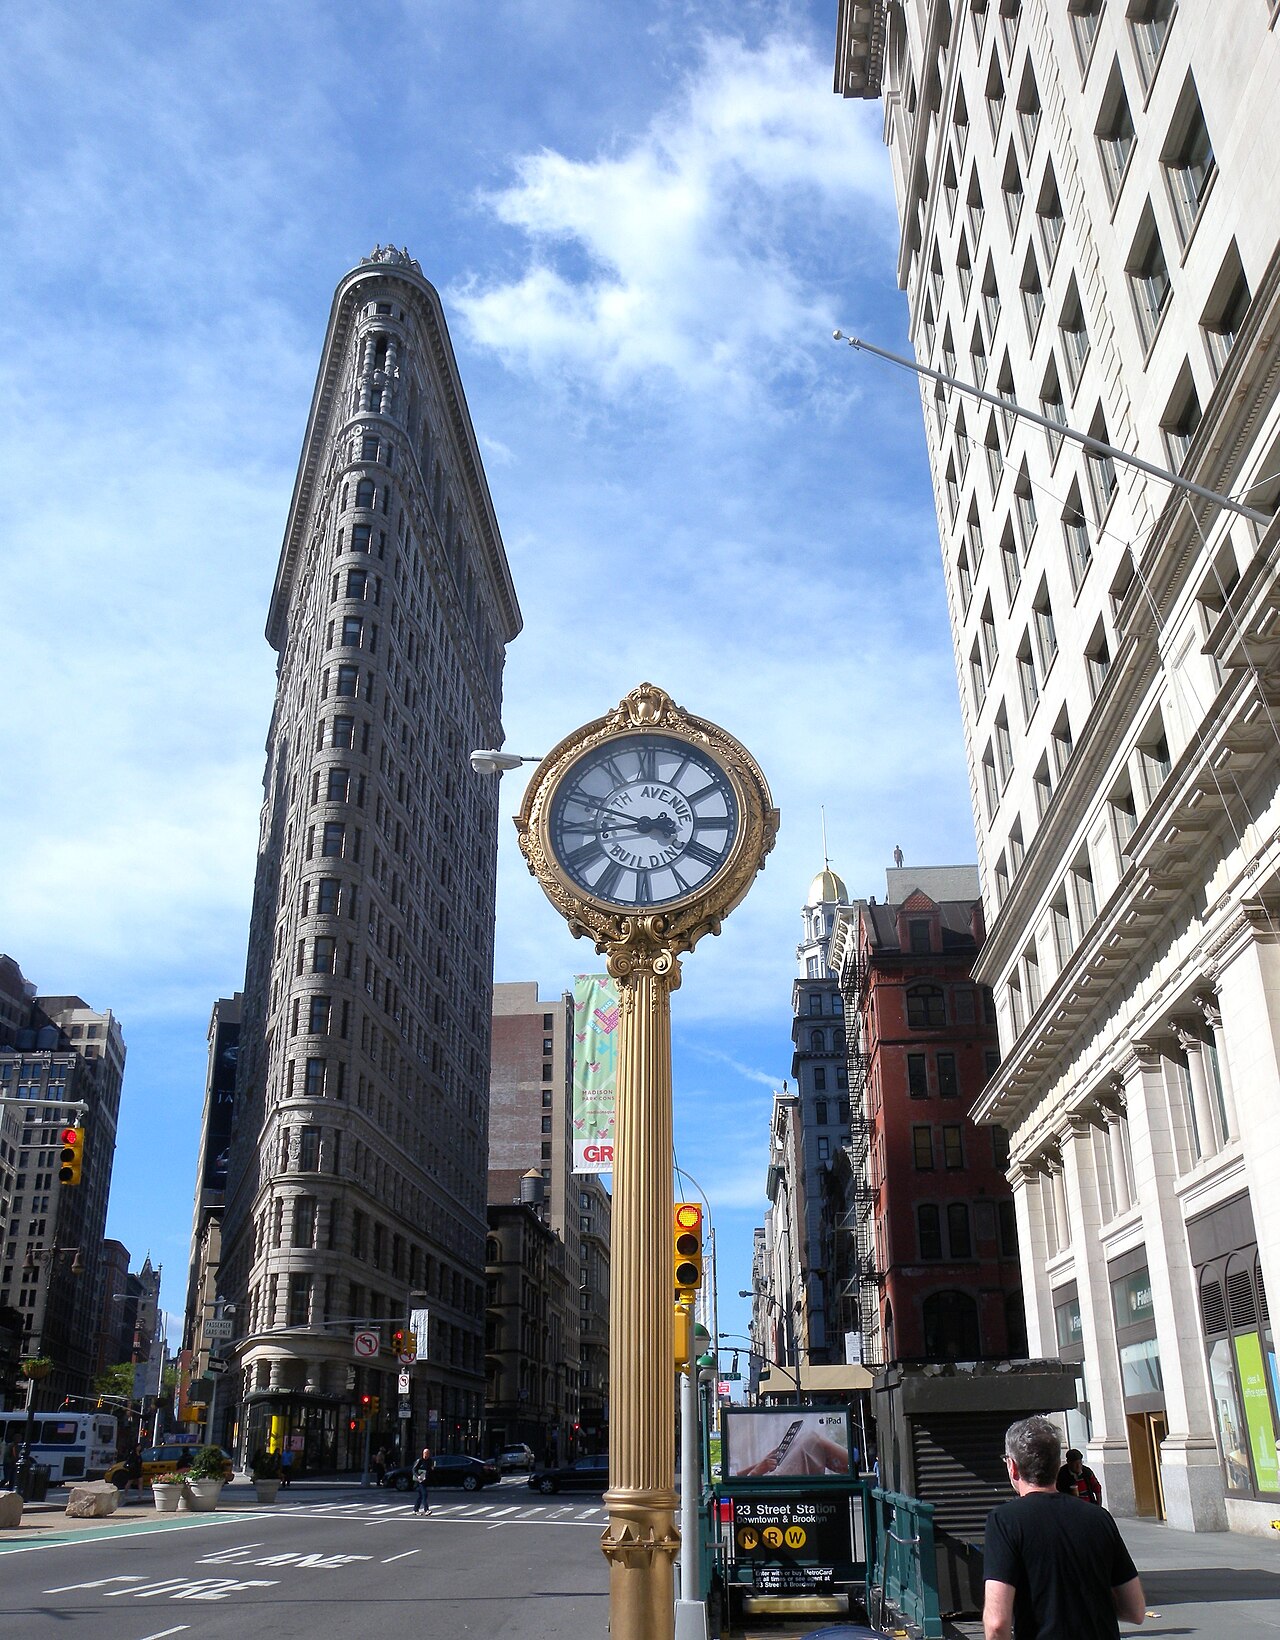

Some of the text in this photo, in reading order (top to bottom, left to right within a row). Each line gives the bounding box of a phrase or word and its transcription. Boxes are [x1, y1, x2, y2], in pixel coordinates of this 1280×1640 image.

[640, 786, 692, 826] AVENUE
[609, 838, 686, 869] BUILDING
[206, 1321, 231, 1329] PASSENGER
[826, 1417, 842, 1425] iPad
[736, 1504, 836, 1515] 23 Street Station
[736, 1515, 827, 1525] Downtown & Brooklyn
[743, 1531, 803, 1545] N R W
